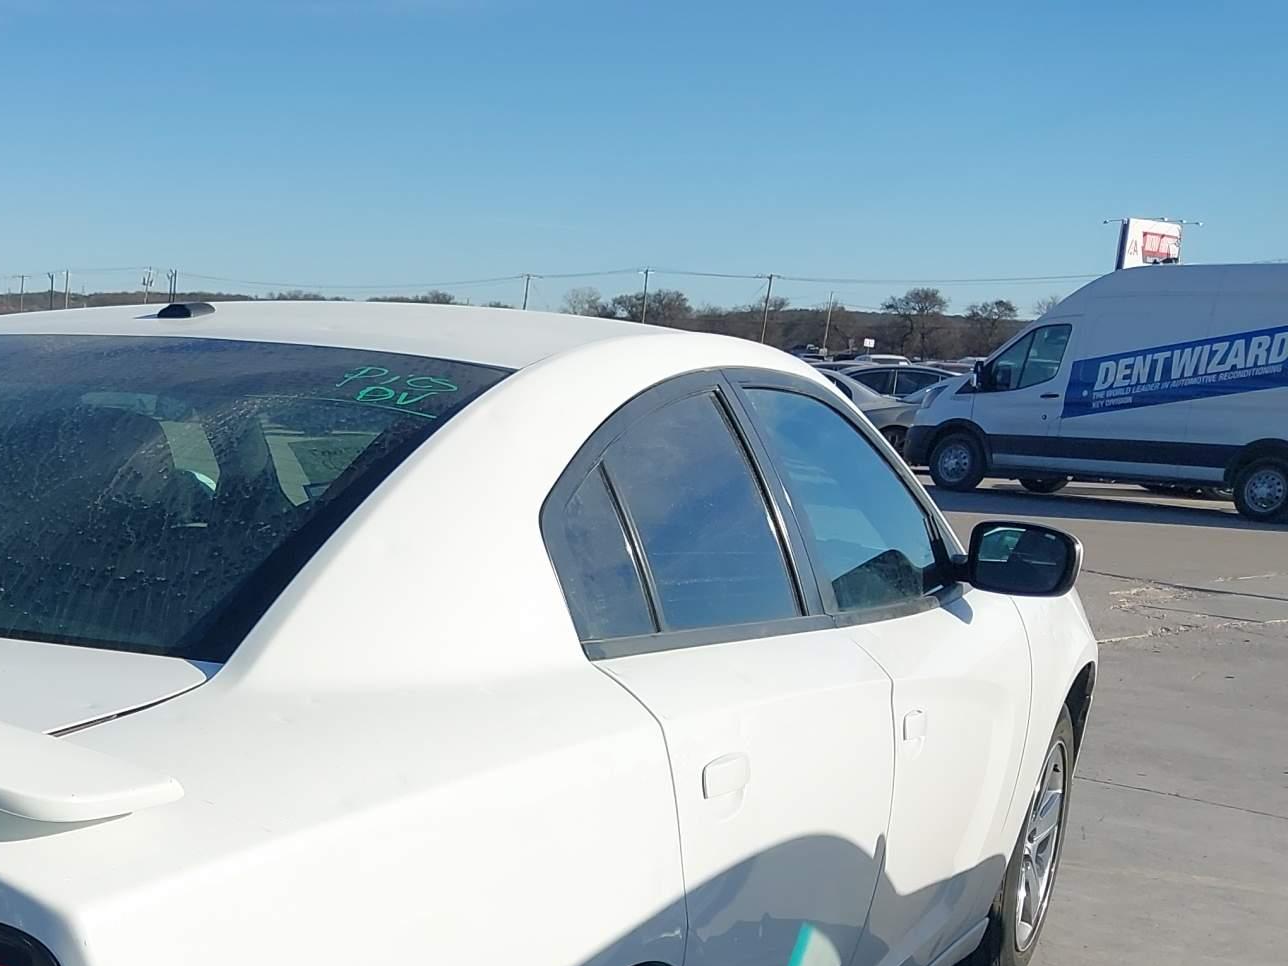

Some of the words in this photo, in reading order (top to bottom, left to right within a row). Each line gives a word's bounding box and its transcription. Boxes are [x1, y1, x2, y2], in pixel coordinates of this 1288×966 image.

[1092, 390, 1105, 399] THE
[1106, 387, 1131, 398] WORLD
[1132, 383, 1160, 394] LEADER
[1170, 374, 1216, 388] AUTOMOTIVE
[1218, 364, 1282, 380] RECONDITIONING
[1093, 352, 1171, 390] DENT
[1171, 332, 1288, 379] WIZARD
